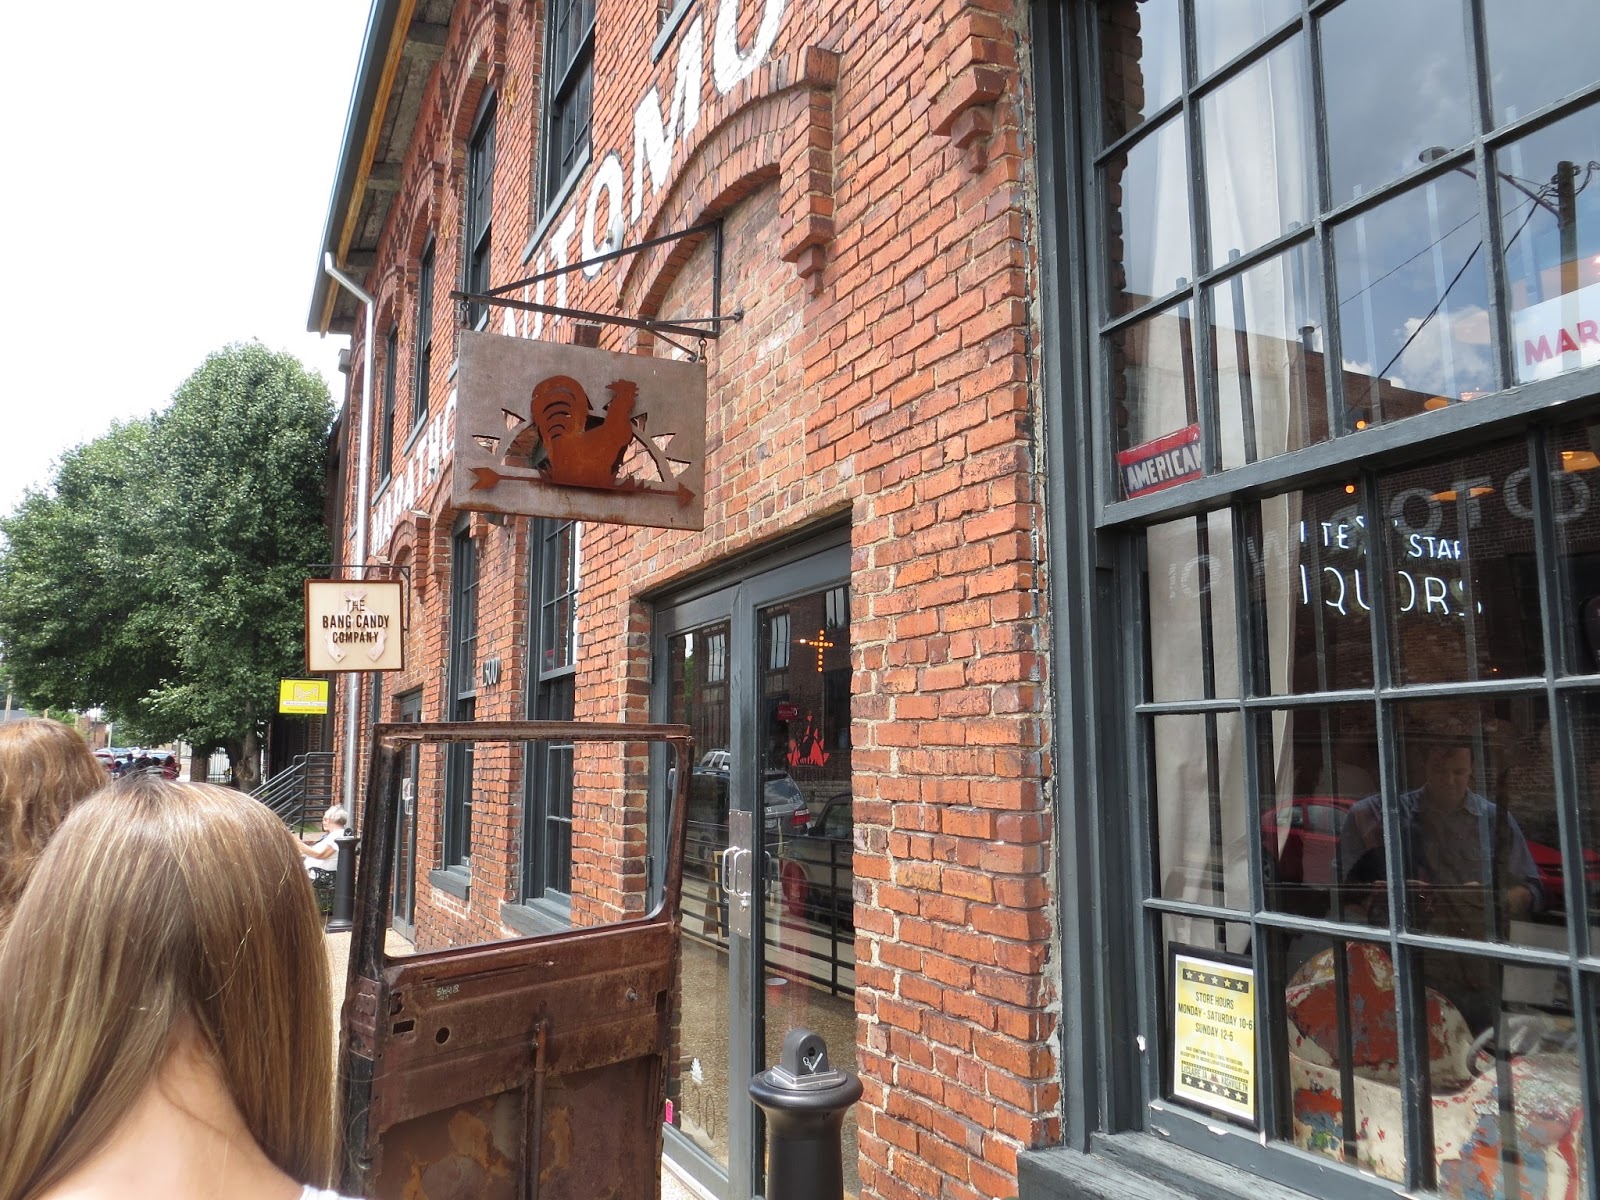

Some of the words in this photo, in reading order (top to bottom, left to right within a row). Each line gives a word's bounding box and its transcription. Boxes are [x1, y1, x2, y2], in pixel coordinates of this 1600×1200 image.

[345, 599, 365, 612] THE
[322, 615, 352, 629] BANG
[356, 614, 390, 629] CANDY
[332, 631, 379, 644] COMPANY
[1195, 992, 1214, 1005] STORE
[1215, 997, 1234, 1010] HOURS
[1178, 1002, 1202, 1018] MONDAY
[1207, 1010, 1237, 1026] SATURDAY
[1239, 1018, 1253, 1031] 10-6
[1195, 1022, 1219, 1038] SUNDAY
[1220, 1029, 1234, 1042] 12-5
